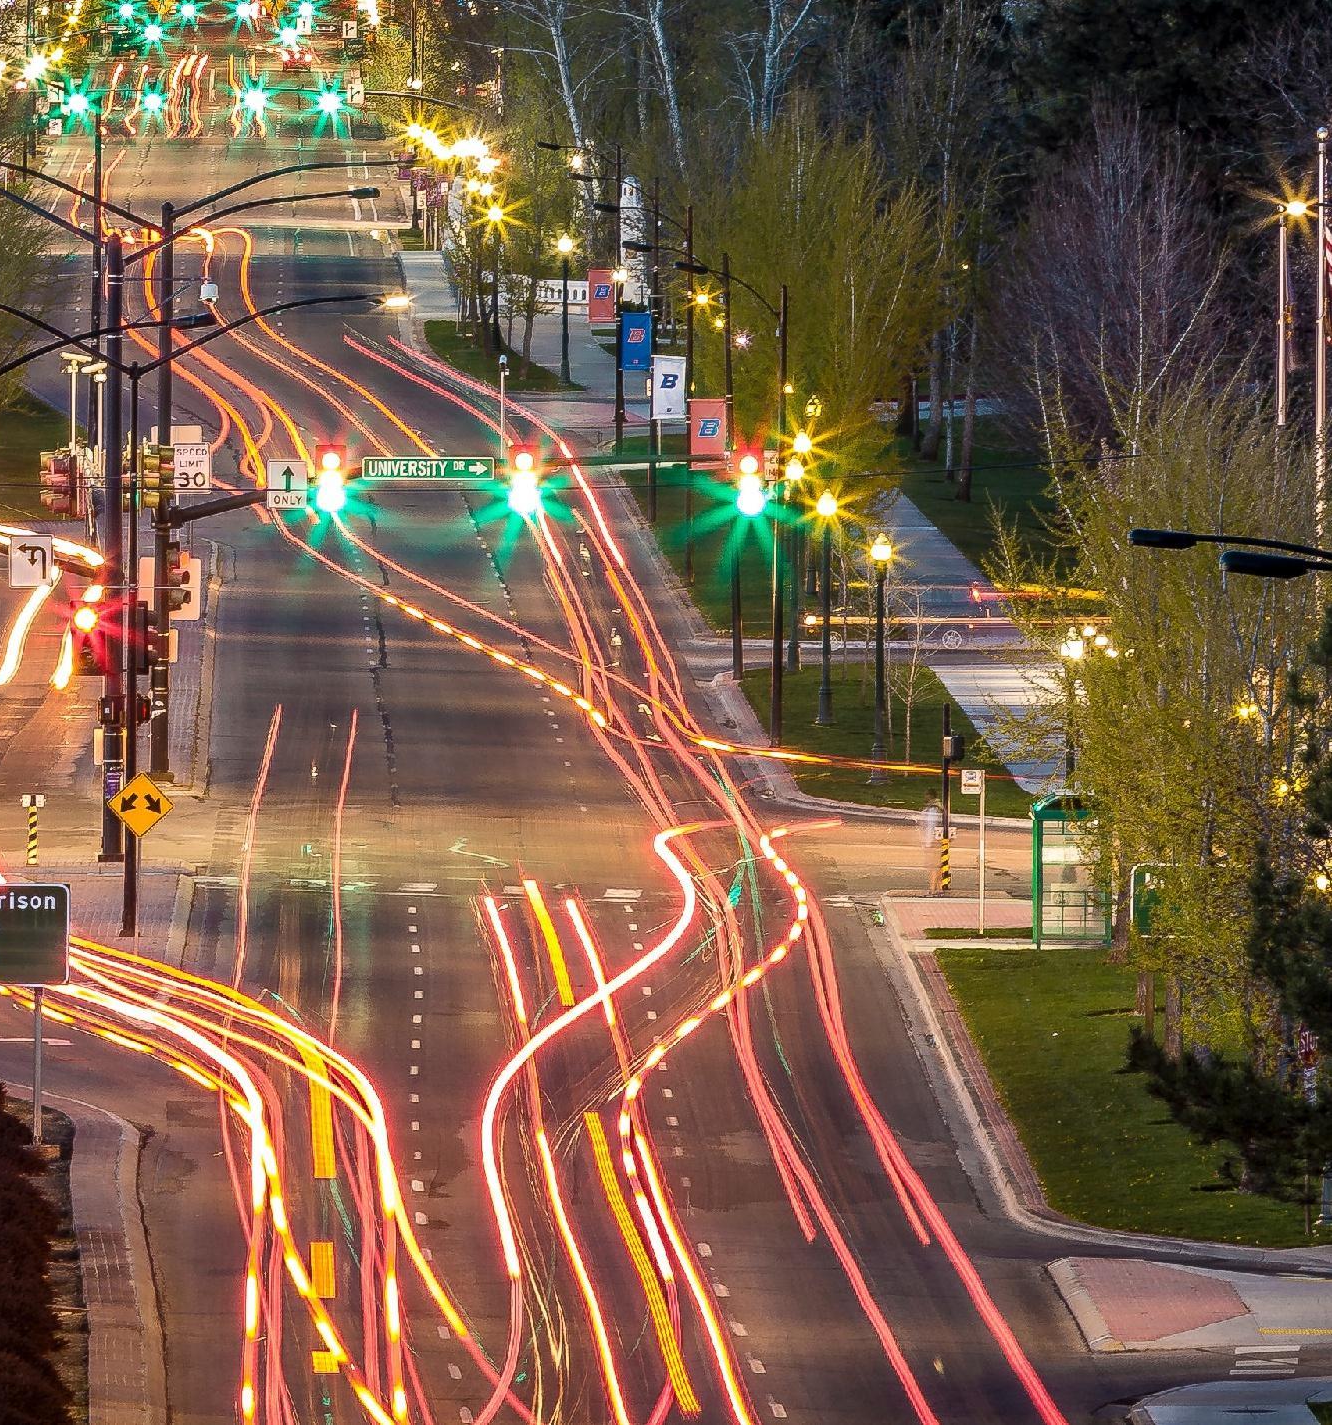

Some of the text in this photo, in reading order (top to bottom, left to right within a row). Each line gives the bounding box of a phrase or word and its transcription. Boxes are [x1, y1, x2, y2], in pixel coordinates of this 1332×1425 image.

[660, 373, 679, 389] B
[697, 418, 721, 438] B
[176, 448, 208, 457] SPEED
[179, 460, 204, 468] LIMIT
[368, 460, 466, 477] UNIVERSITY DR
[177, 471, 206, 488] 30
[273, 494, 303, 506] ONLY
